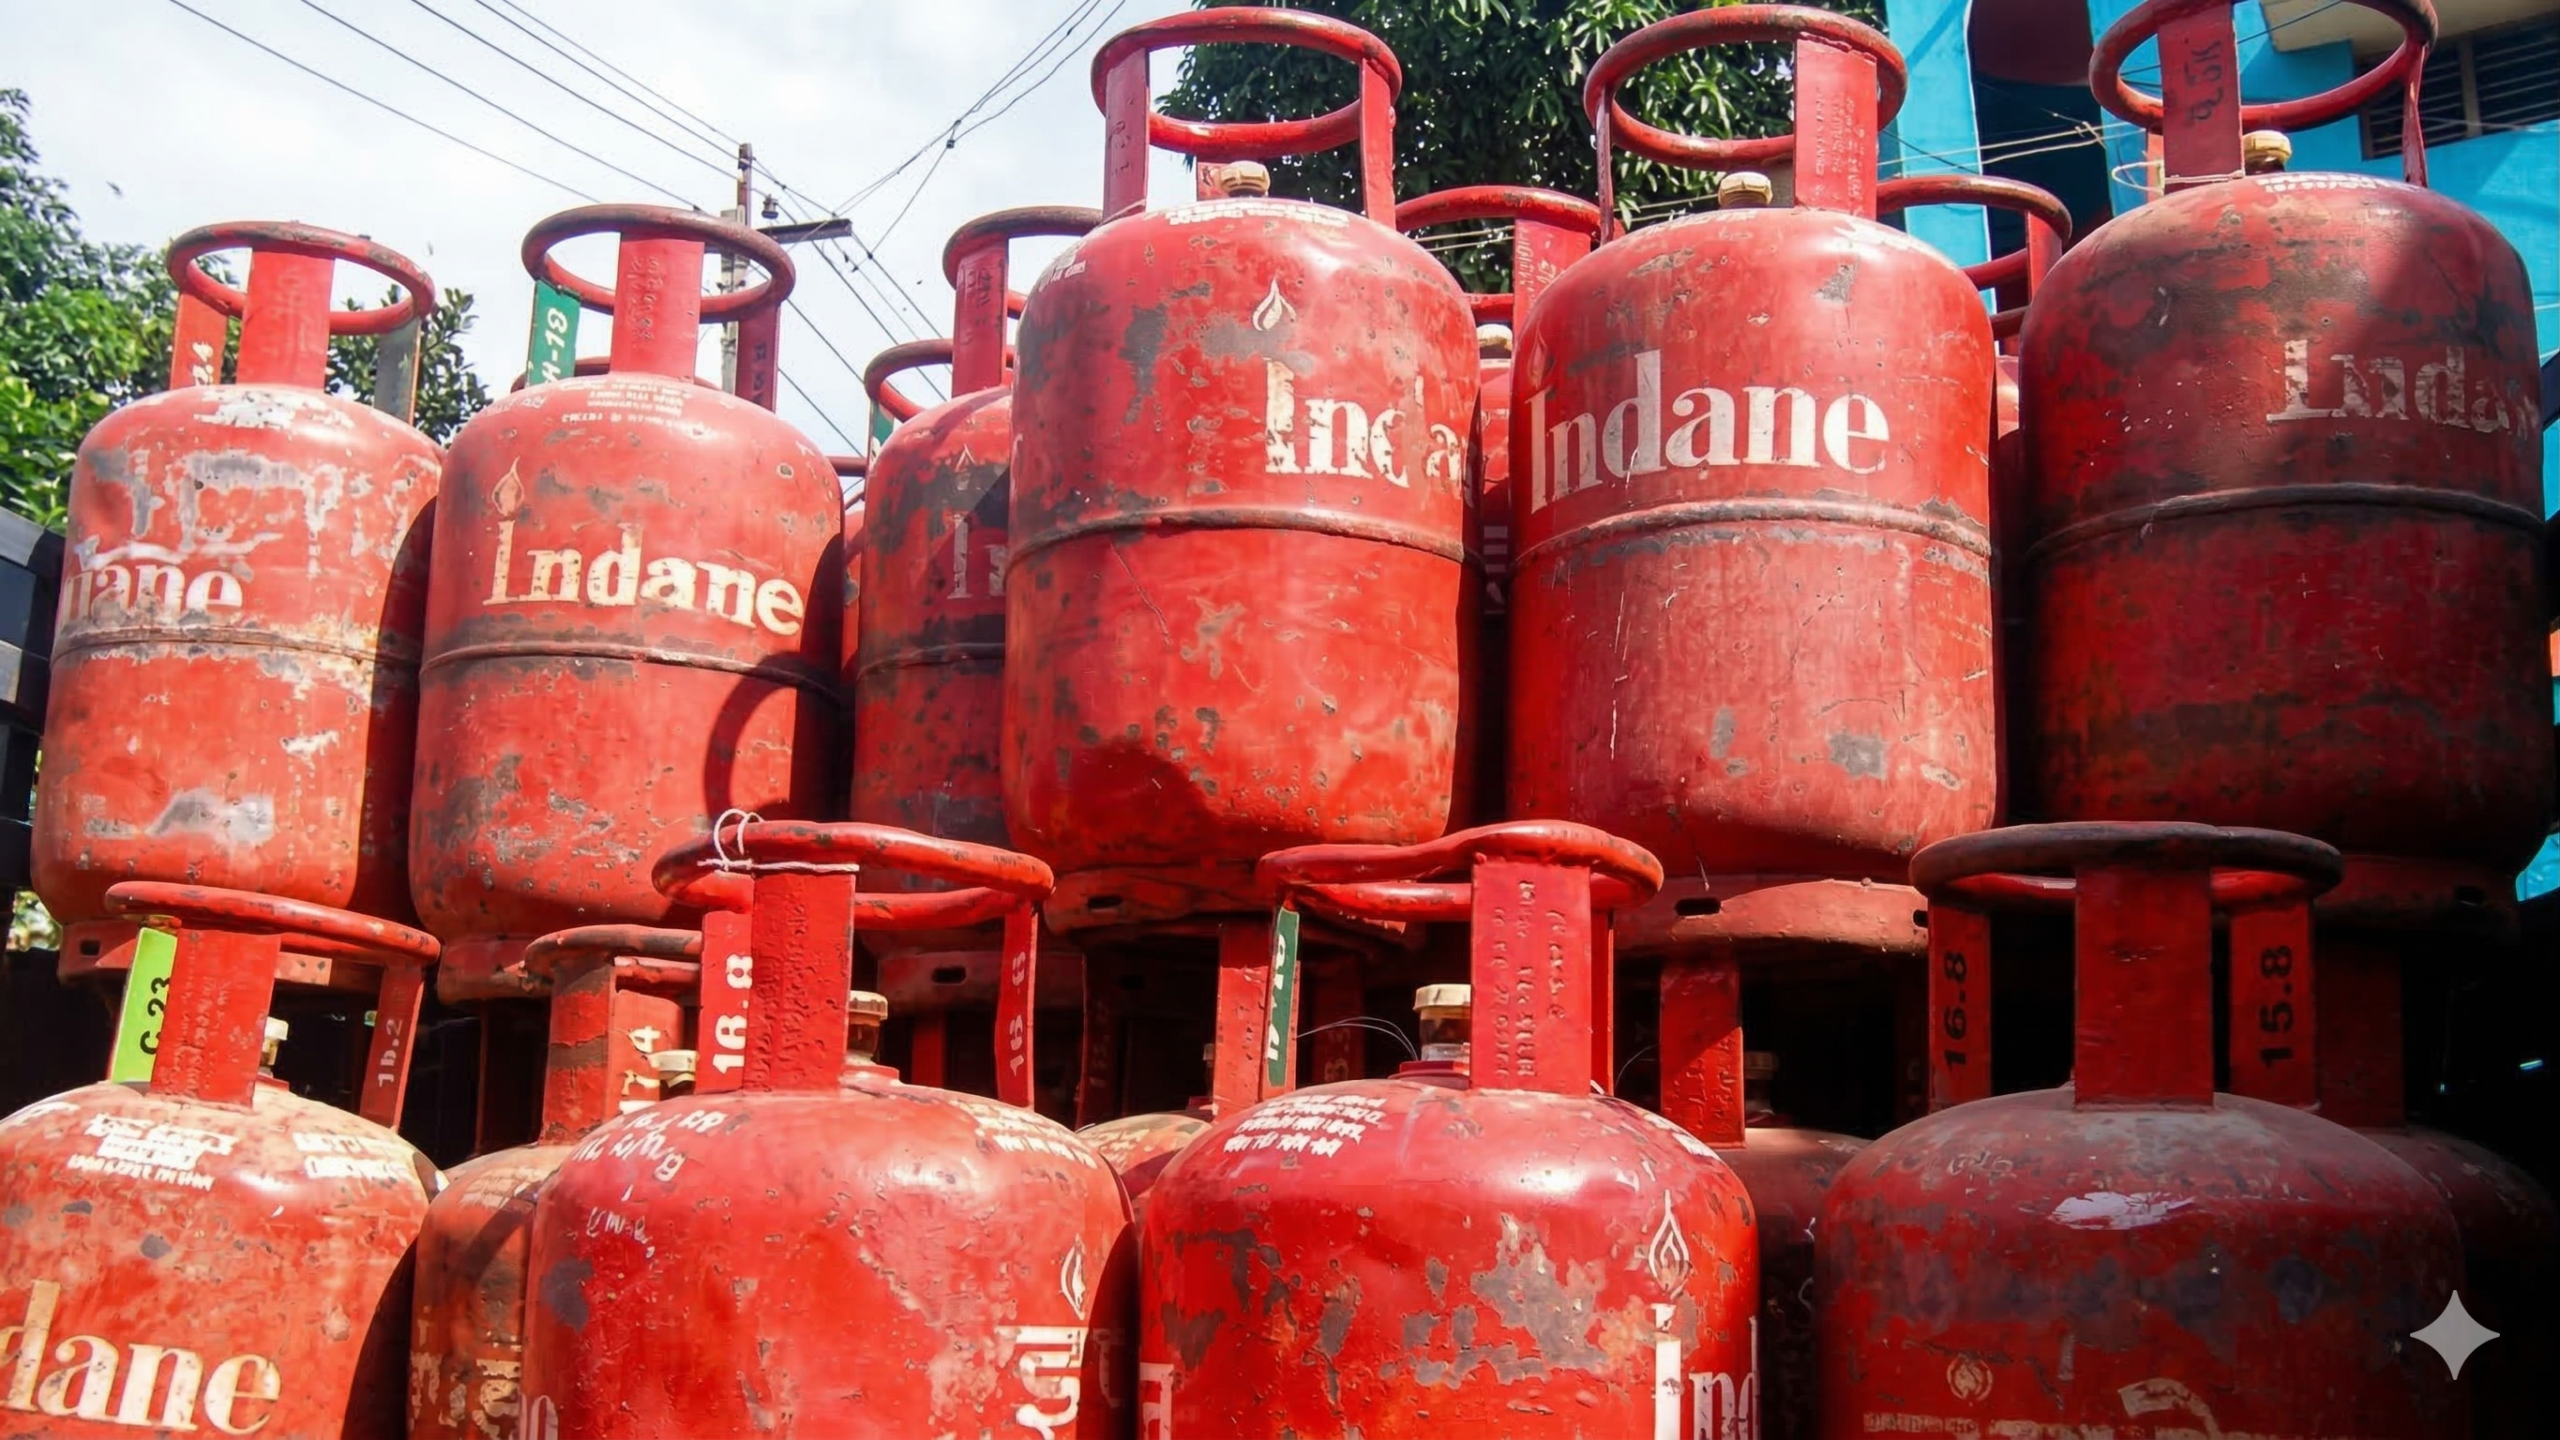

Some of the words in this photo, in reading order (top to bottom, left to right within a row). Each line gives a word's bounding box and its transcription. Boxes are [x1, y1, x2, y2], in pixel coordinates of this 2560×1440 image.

[1525, 349, 1890, 514] Indane
[482, 520, 803, 636] Indane
[1943, 951, 1967, 1071] 16.8
[2260, 945, 2294, 1069] 15.8
